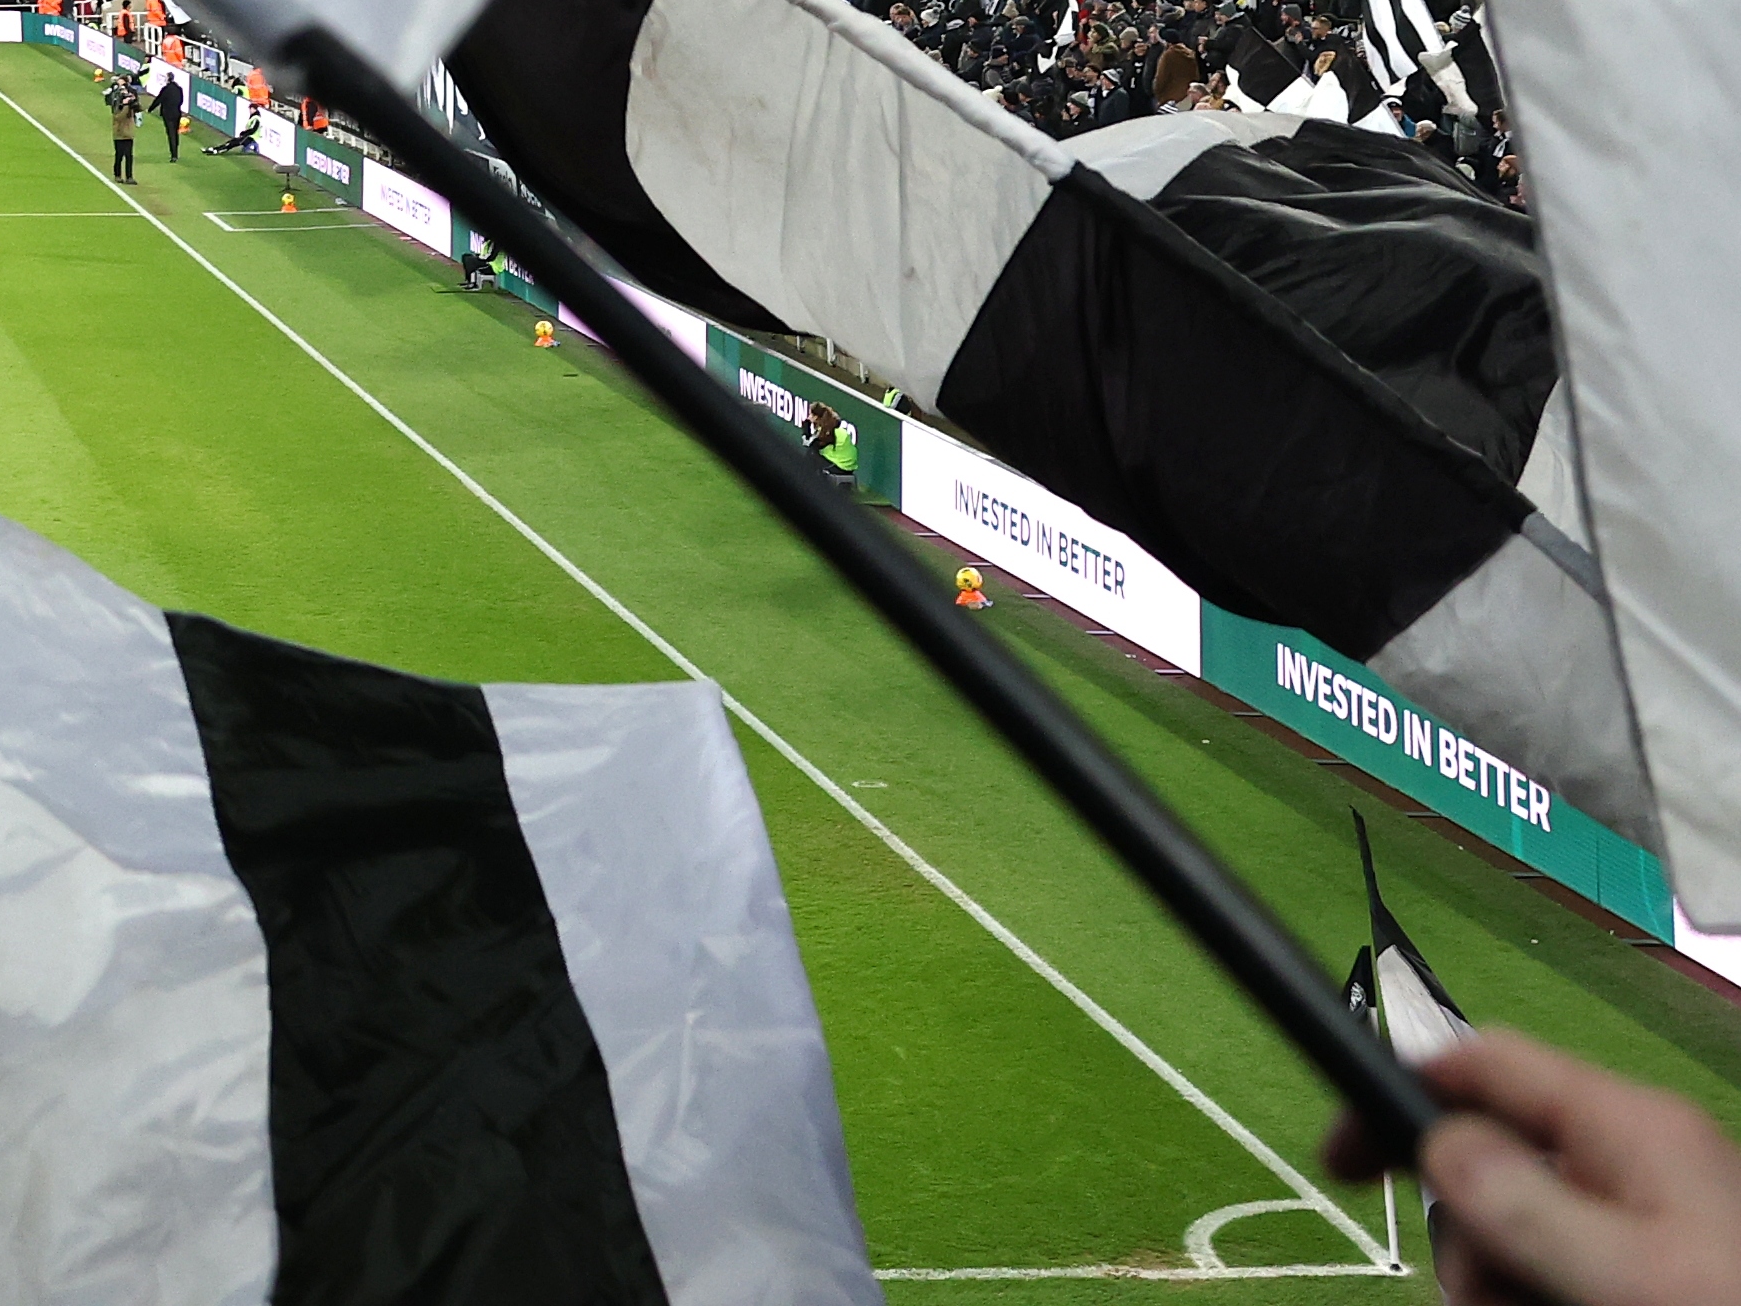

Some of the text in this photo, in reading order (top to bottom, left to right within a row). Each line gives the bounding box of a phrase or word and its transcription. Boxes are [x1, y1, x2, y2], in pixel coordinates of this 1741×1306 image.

[739, 367, 809, 428] INVESTED IN
[955, 479, 1125, 599] INVESTED IN BETTER
[1276, 642, 1551, 833] INVESTED IN BETTER
